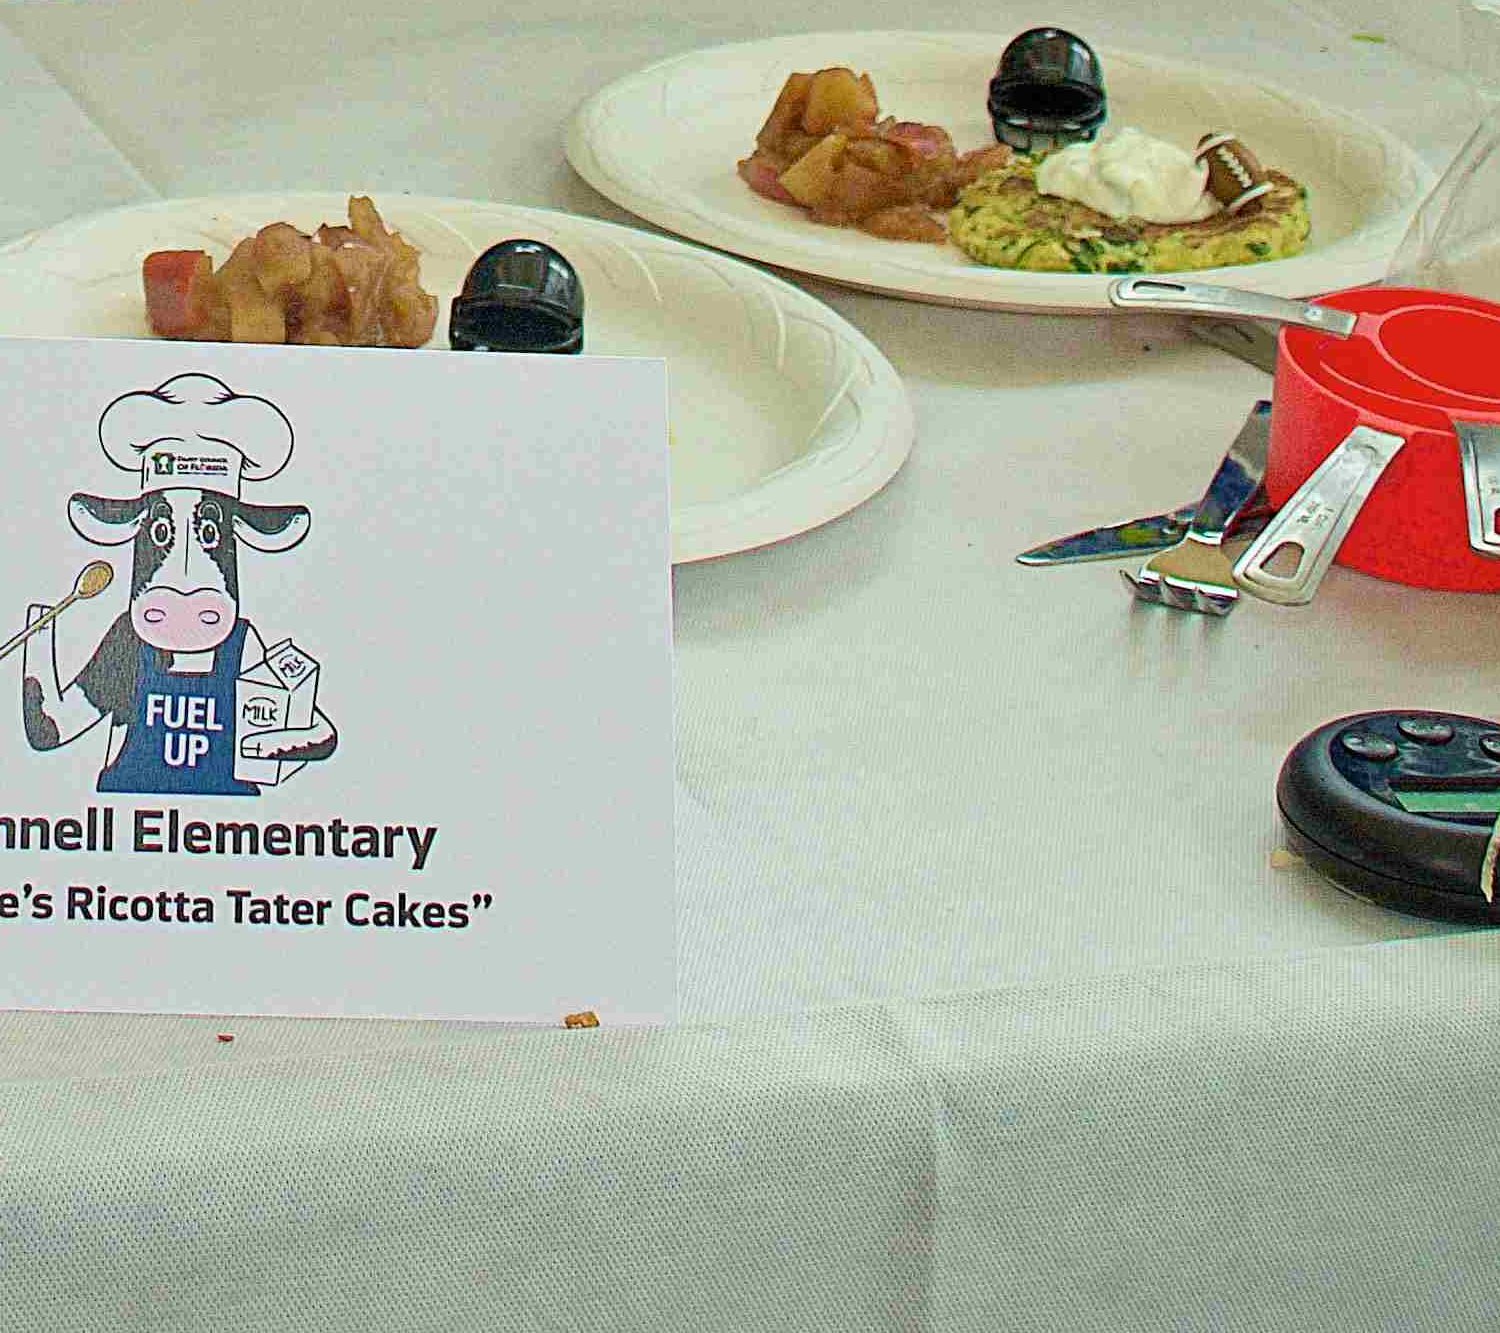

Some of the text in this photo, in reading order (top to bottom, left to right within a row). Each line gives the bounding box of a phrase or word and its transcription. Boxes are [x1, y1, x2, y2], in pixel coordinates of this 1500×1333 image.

[146, 693, 223, 731] FUEL
[242, 702, 278, 722] MILK
[163, 732, 209, 767] UP
[132, 808, 438, 871] Elementary
[67, 886, 215, 925] Ricotta
[225, 889, 332, 928] Tater
[343, 892, 493, 930] Cakes”
